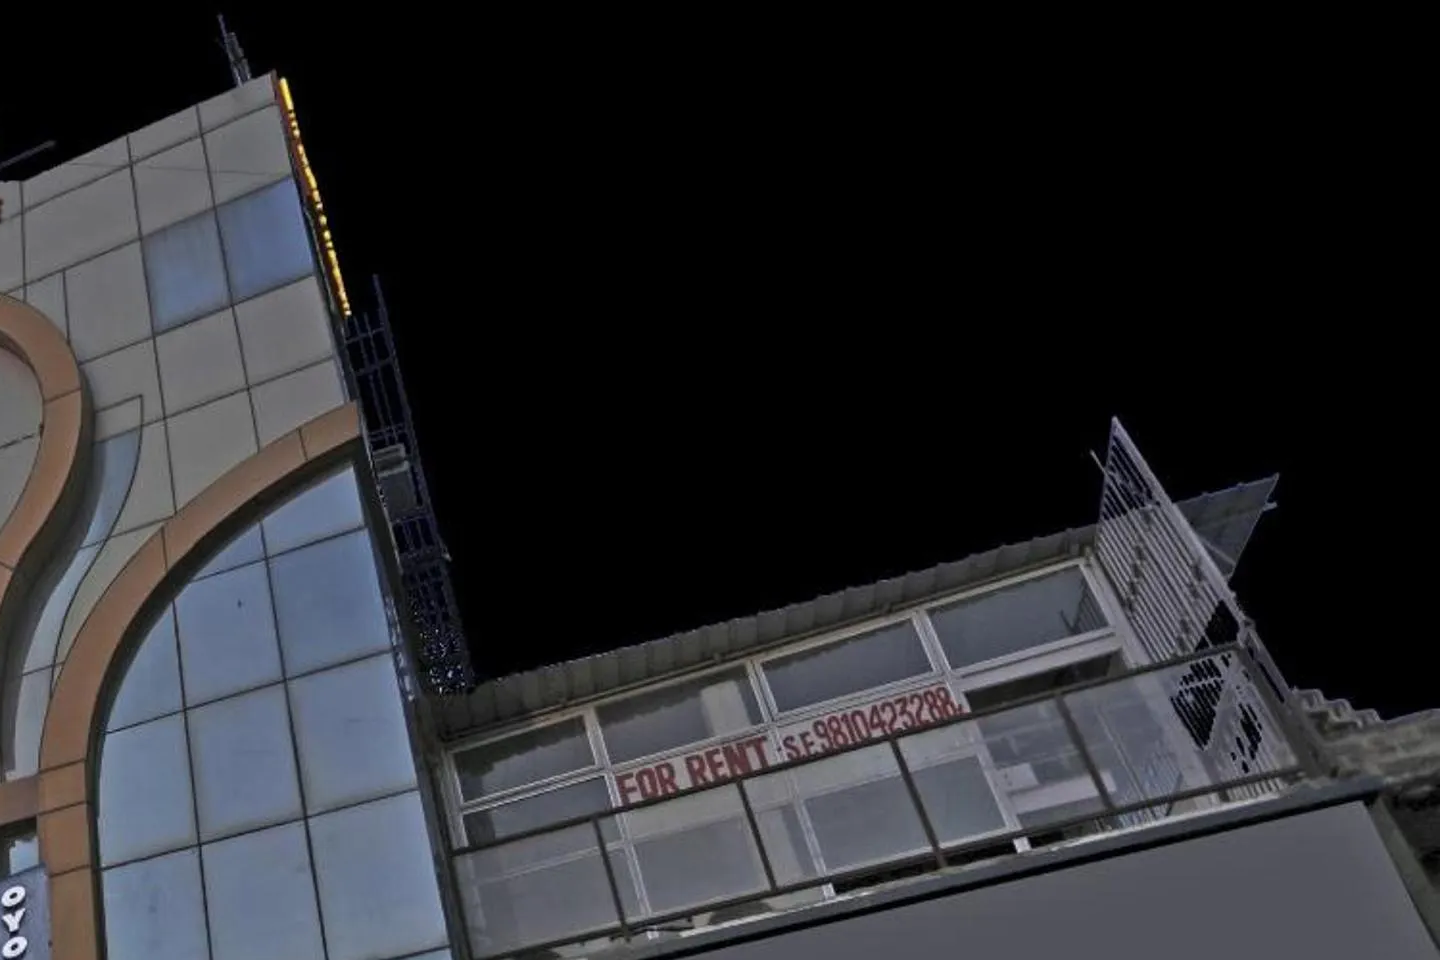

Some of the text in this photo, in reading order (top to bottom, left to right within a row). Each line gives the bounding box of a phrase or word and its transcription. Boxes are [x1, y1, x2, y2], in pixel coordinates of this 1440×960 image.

[615, 762, 678, 805] FOR
[684, 735, 771, 788] RENT
[1, 885, 27, 958] OYO
